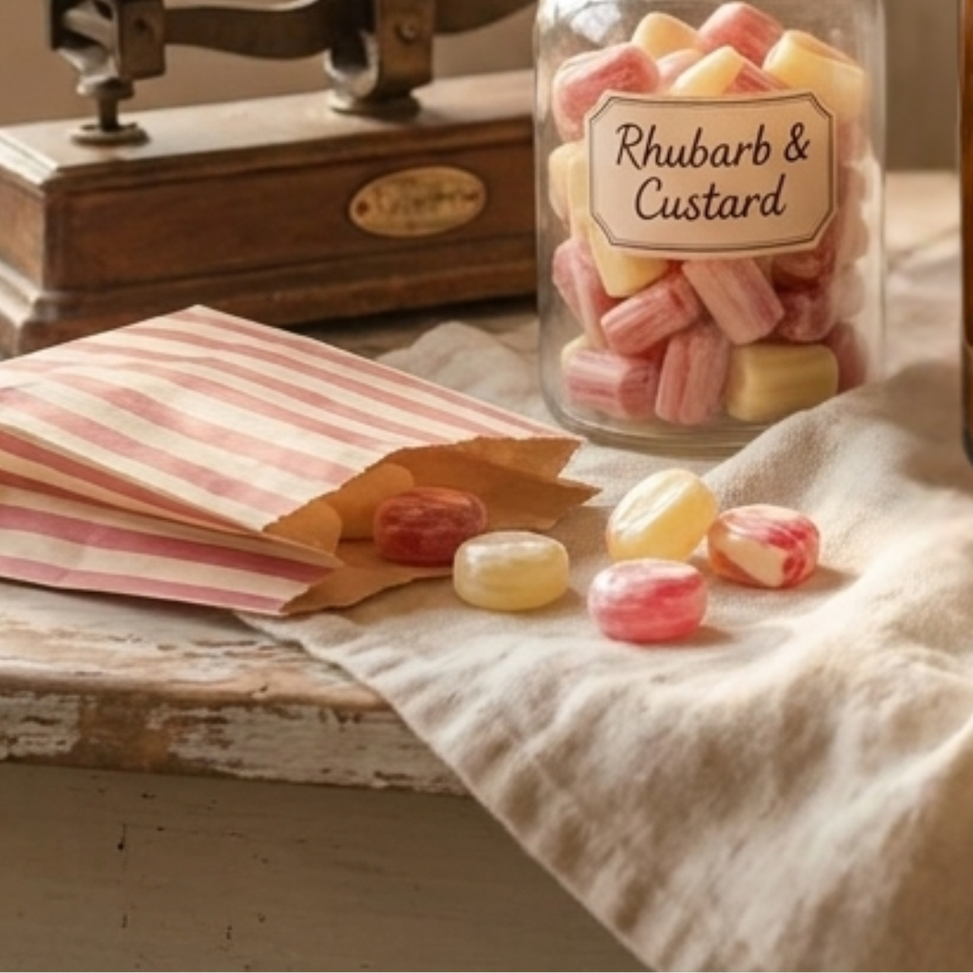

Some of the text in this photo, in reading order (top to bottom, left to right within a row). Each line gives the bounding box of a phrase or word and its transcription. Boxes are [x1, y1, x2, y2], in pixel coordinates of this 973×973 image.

[615, 121, 811, 171] Rhubarb &
[634, 172, 788, 222] Custard
